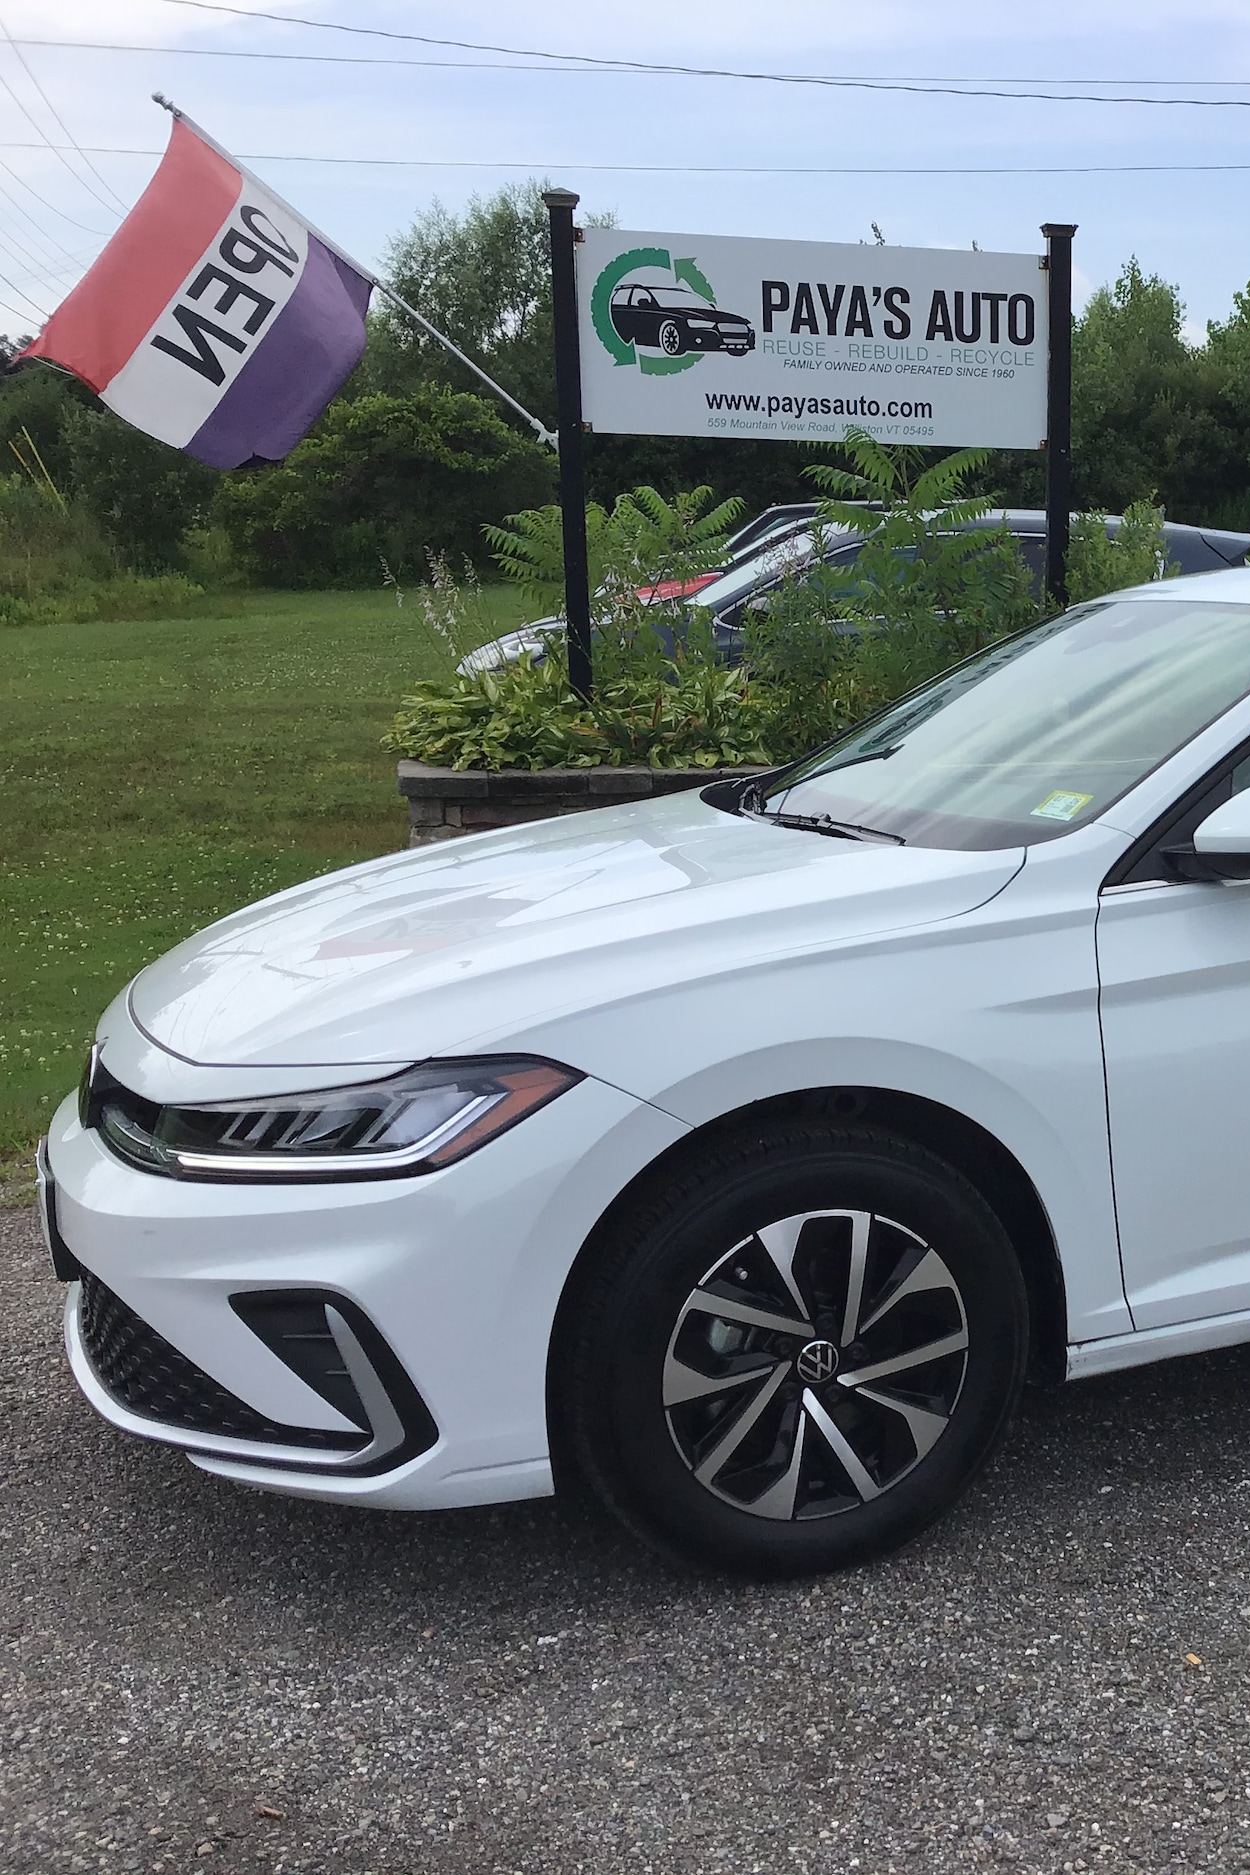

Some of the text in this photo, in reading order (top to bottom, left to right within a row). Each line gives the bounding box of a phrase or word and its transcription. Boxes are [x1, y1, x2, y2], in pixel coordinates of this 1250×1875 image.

[762, 280, 1035, 346] PAYA'S AUTO
[763, 339, 826, 357] REUSE
[848, 343, 929, 361] REBUILD
[950, 348, 1035, 367] RECYCLE
[783, 359, 1015, 379] FAMILY OWNED AND OPERATED SINCE 1960
[705, 393, 933, 419] www.payasauto.com
[707, 418, 727, 428] 559
[730, 419, 777, 430] Mountain
[781, 421, 805, 431] View
[808, 422, 838, 433] Road,
[886, 424, 901, 435] VT
[902, 425, 934, 436] 05495
